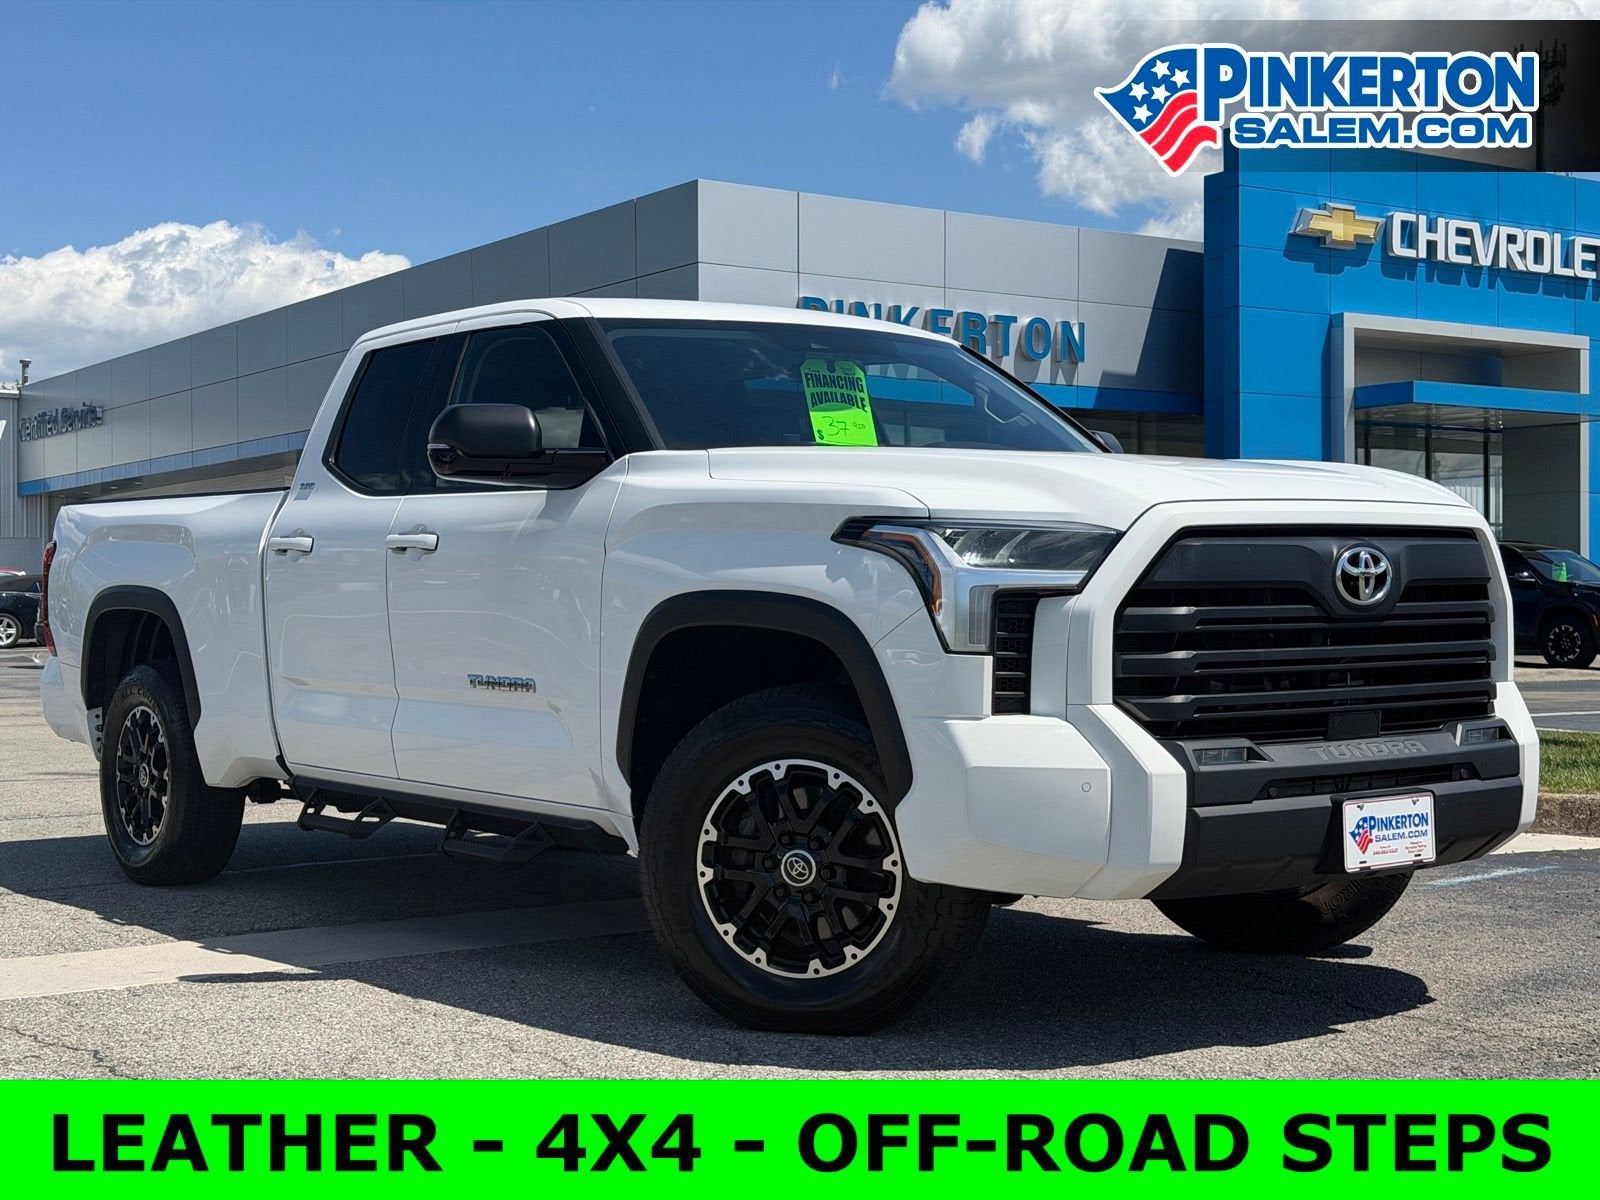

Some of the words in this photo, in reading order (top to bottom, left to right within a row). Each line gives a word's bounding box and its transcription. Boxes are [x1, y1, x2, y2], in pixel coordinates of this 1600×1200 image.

[804, 373, 864, 393] FINANCING
[811, 391, 868, 413] AVAILABLE
[467, 674, 536, 693] TUNDRA
[1306, 737, 1428, 761] TUNDRA
[1369, 812, 1428, 836] PINKERTON
[1375, 830, 1428, 843] SALEM.COM
